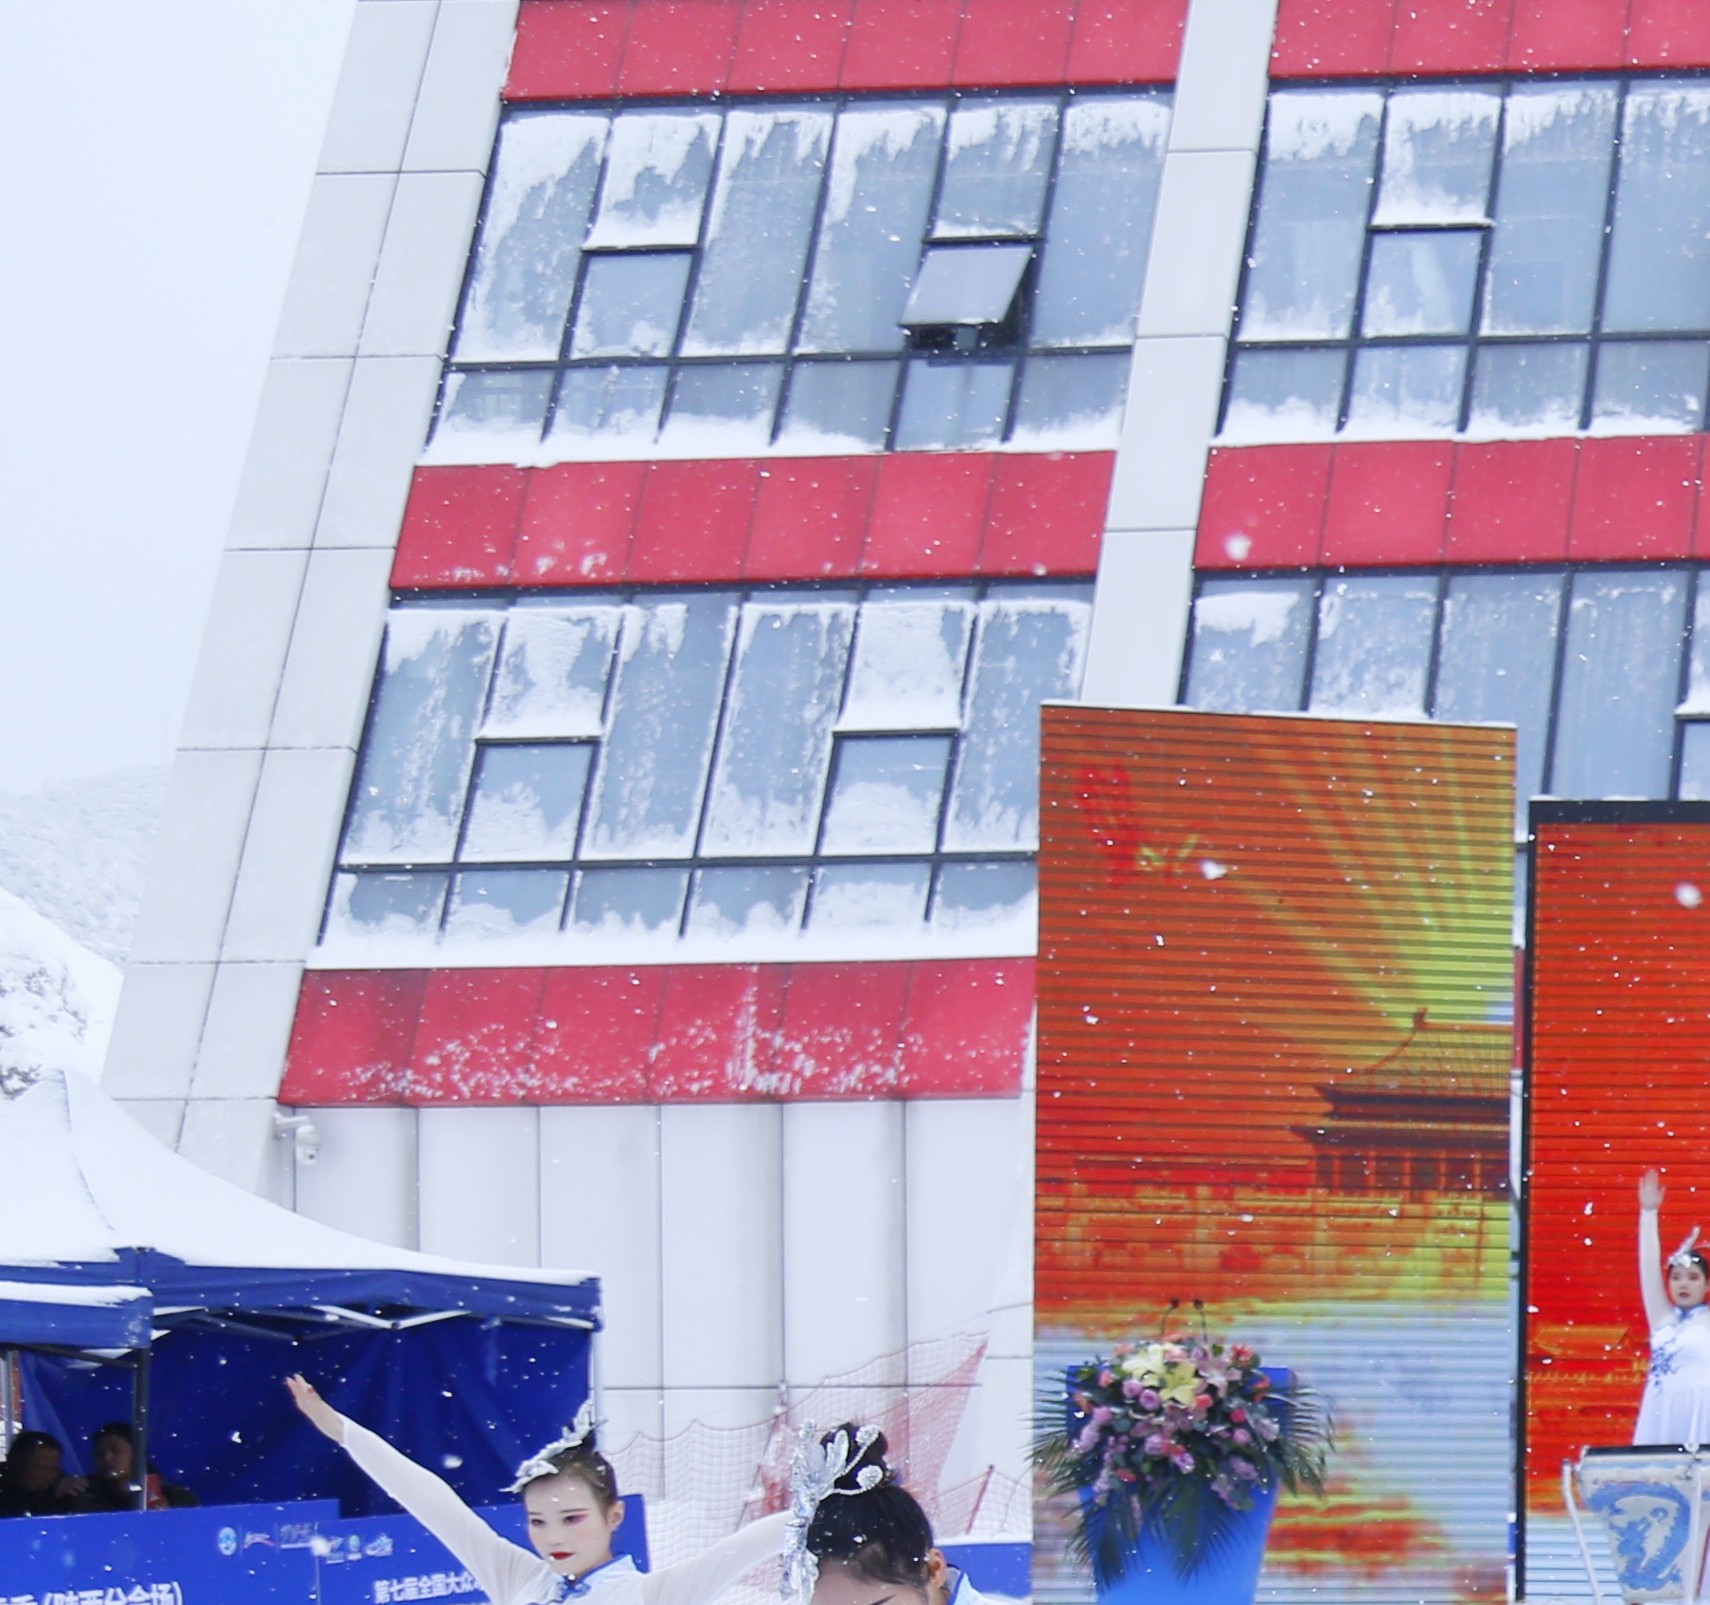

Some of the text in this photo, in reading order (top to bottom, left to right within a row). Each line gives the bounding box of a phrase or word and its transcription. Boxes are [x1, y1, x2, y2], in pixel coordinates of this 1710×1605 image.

[374, 1568, 487, 1604] 第七届全国大众
